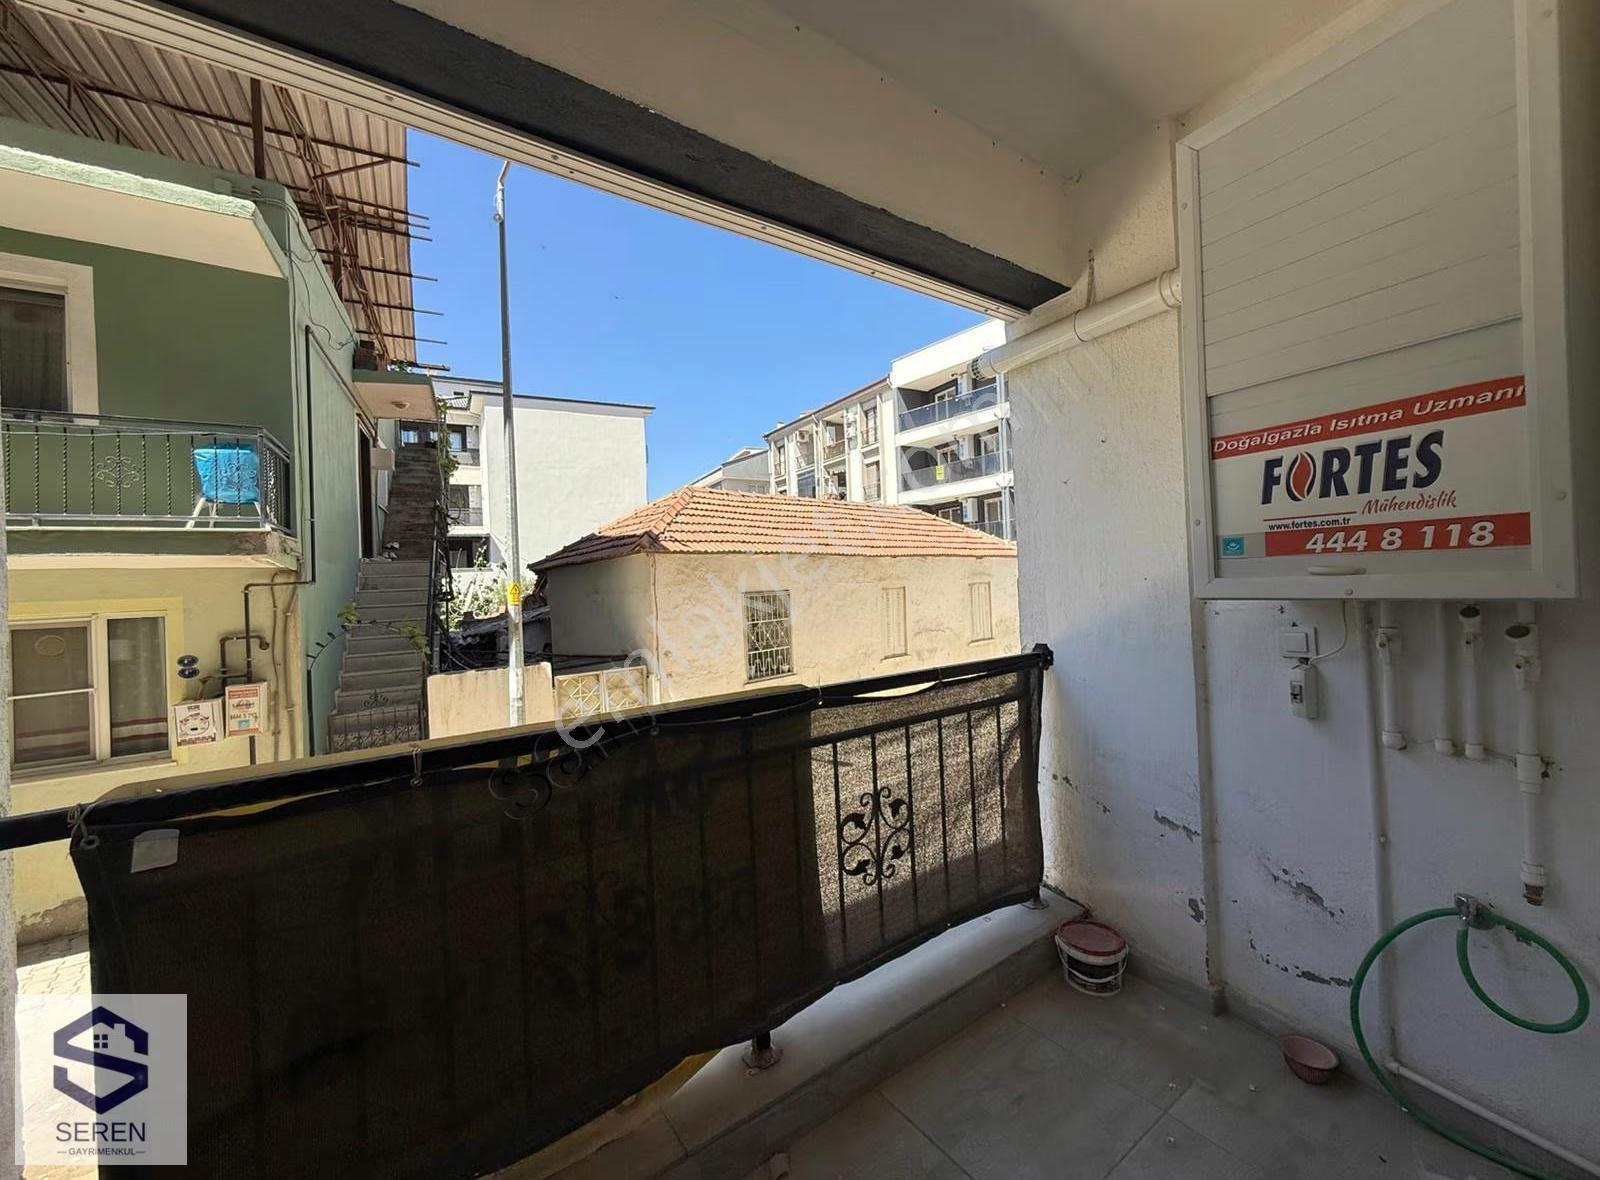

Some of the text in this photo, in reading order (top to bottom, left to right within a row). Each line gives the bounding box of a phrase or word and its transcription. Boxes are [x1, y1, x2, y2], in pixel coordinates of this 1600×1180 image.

[1213, 384, 1526, 452] Doğalgazla Isıtma Uzmanı
[1261, 429, 1444, 504] FORTES
[1362, 490, 1457, 515] Mühendislik
[1268, 516, 1351, 531] www.fortes.com.tr
[1305, 521, 1495, 553] 444 8 118
